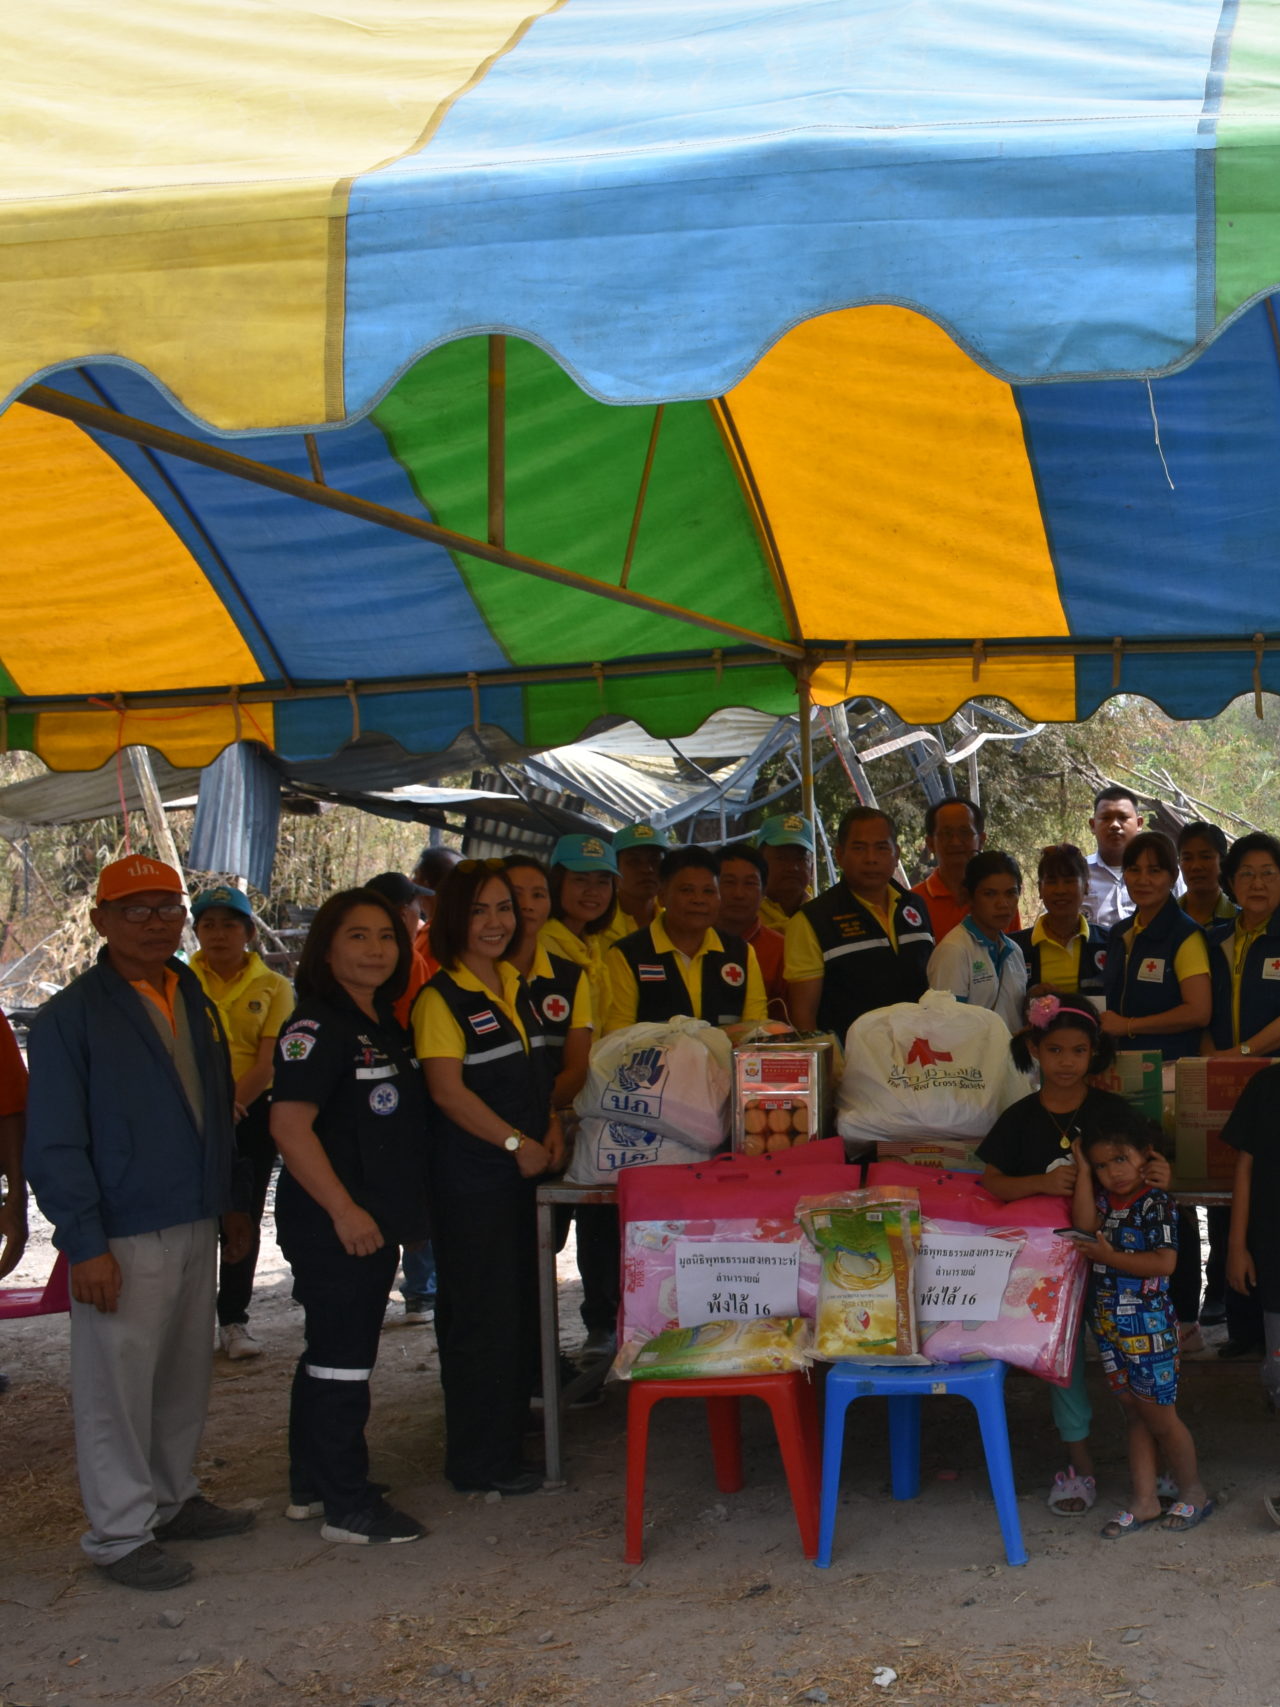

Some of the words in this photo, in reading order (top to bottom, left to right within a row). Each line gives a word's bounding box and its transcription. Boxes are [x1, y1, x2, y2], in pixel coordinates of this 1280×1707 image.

[128, 861, 160, 877] ปภ.
[932, 1080, 957, 1088] Cross
[610, 1095, 652, 1116] ปภ.
[679, 1252, 797, 1269] มูลนิธิพุทธธรรมสงเคราะห์
[716, 1272, 760, 1284] ลำนารายณ์
[961, 1293, 978, 1306] 16
[754, 1303, 771, 1316] 16
